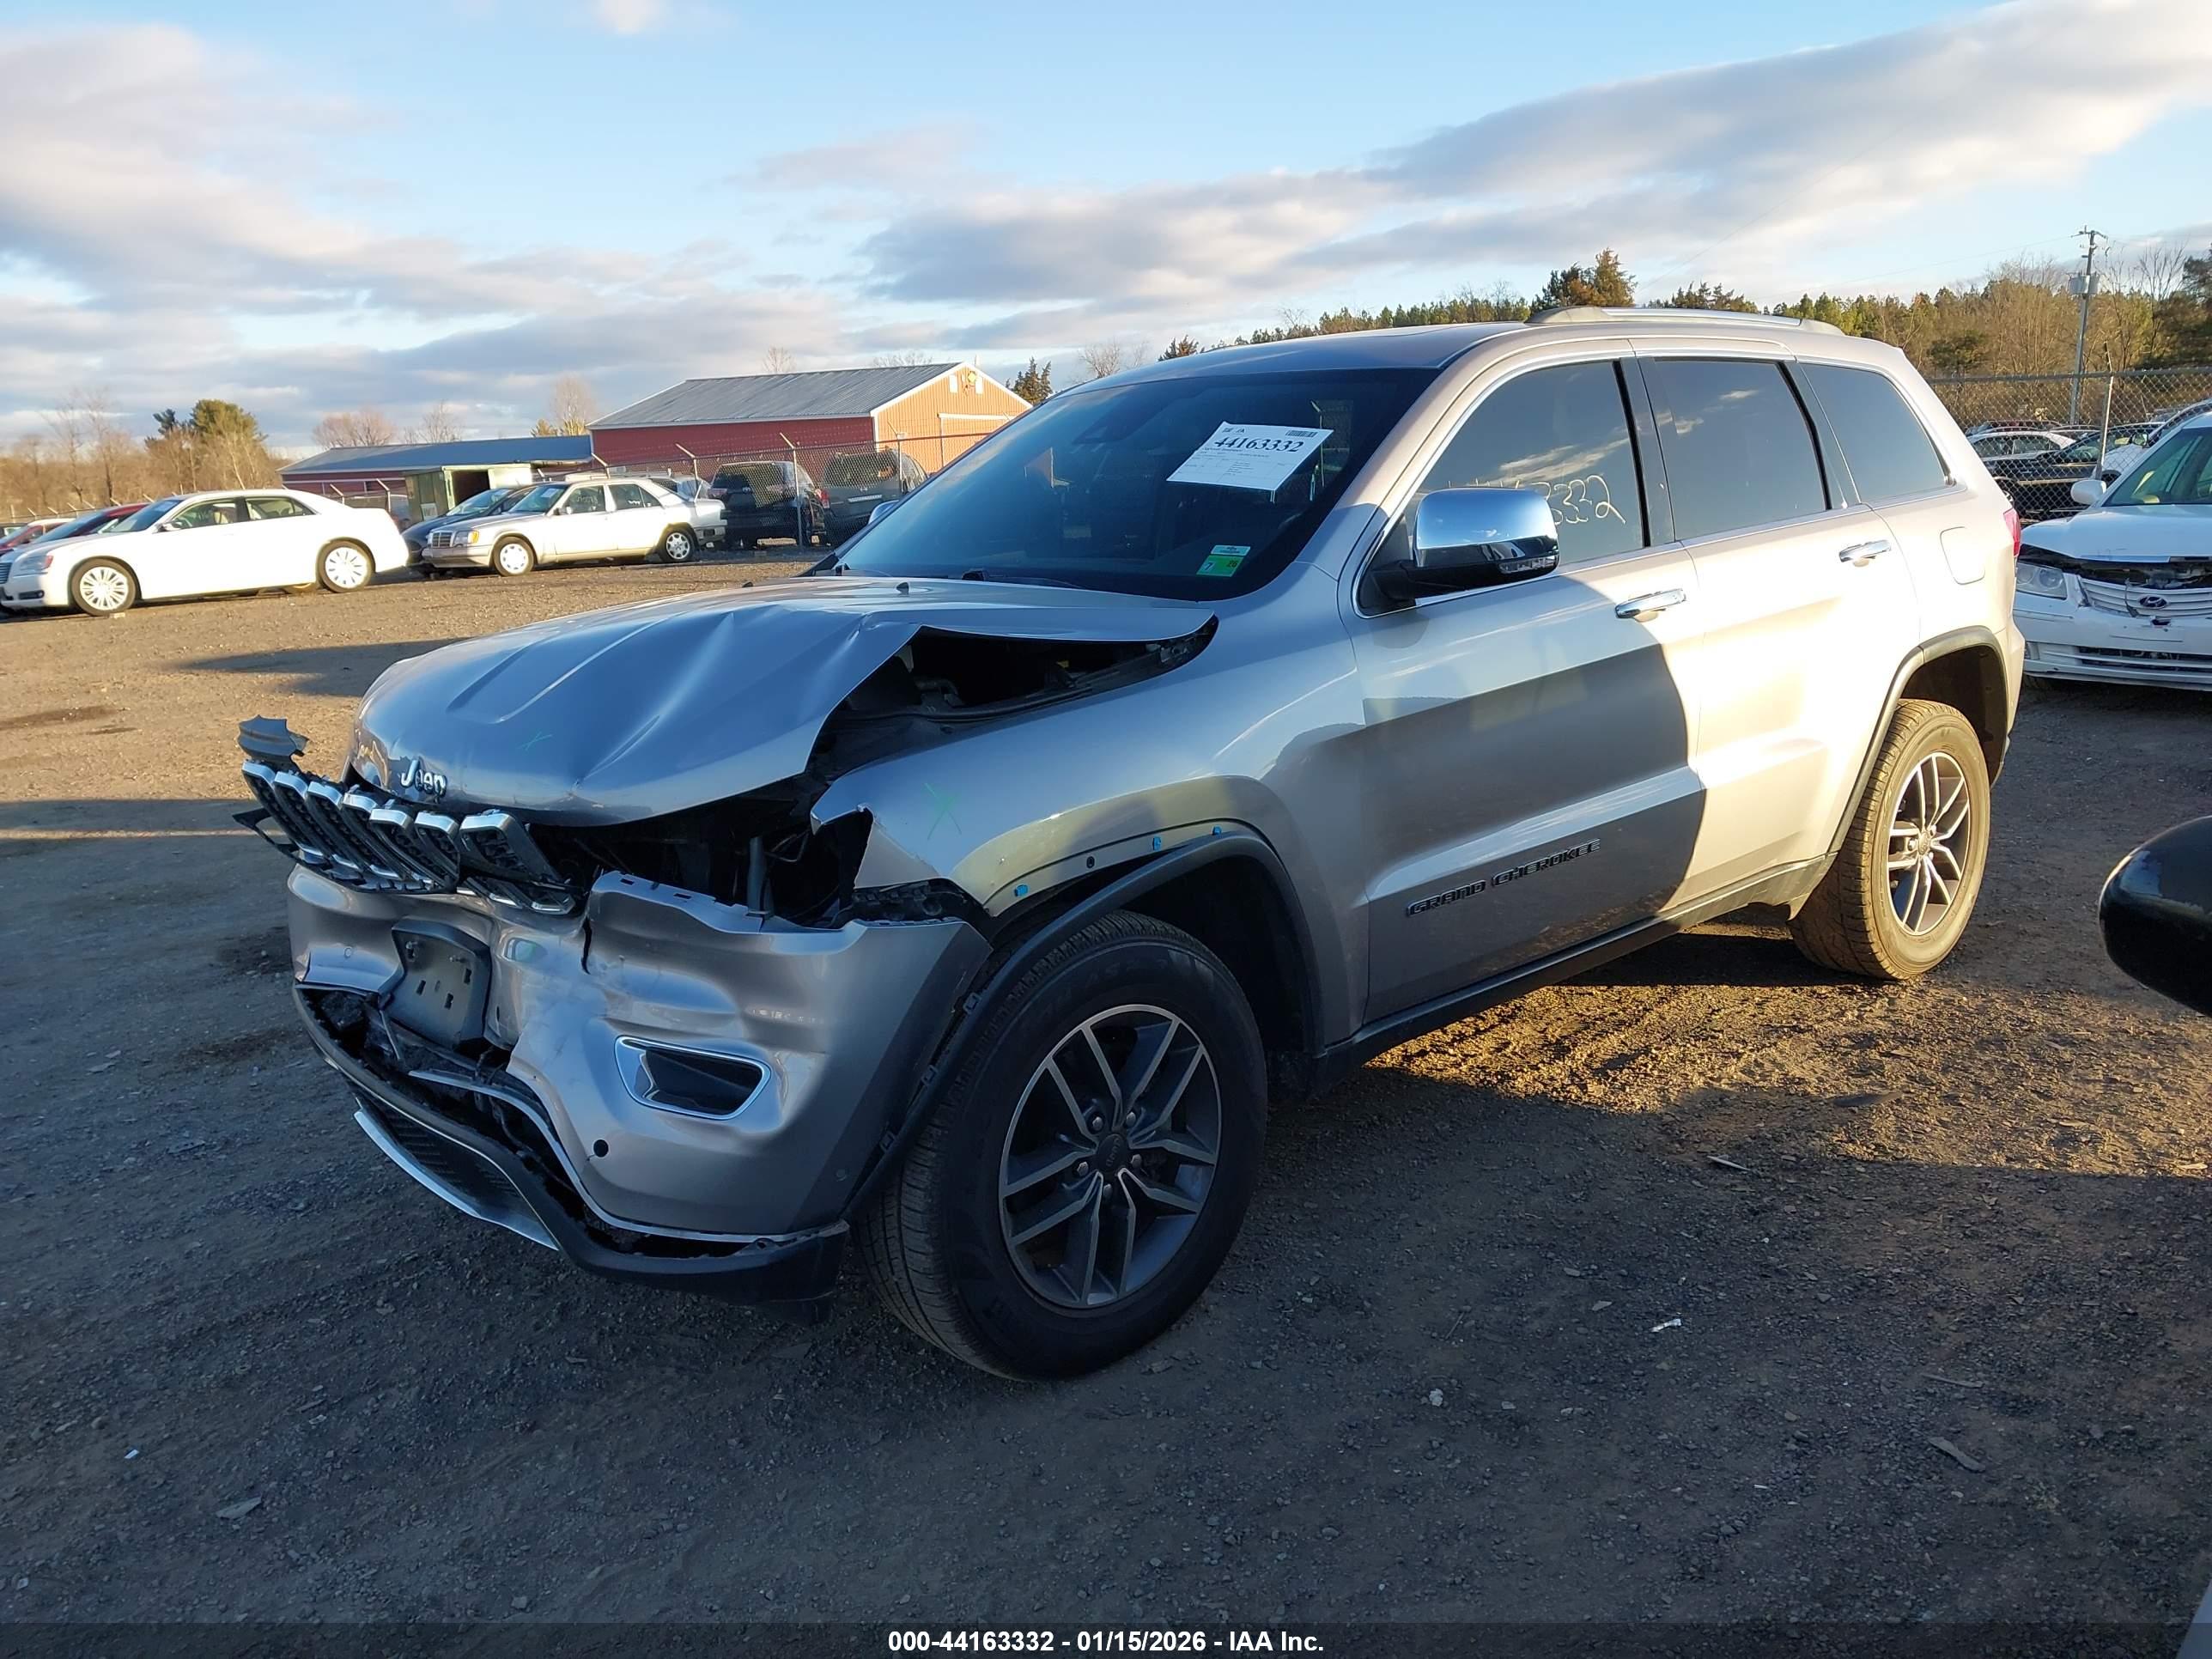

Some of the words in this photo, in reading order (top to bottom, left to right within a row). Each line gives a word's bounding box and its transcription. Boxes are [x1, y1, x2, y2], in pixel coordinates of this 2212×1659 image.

[1214, 436, 1304, 453] 44163332
[400, 758, 447, 804] Jeep
[1406, 879, 1486, 917] GRAND
[1491, 838, 1601, 887] CHEROKEE
